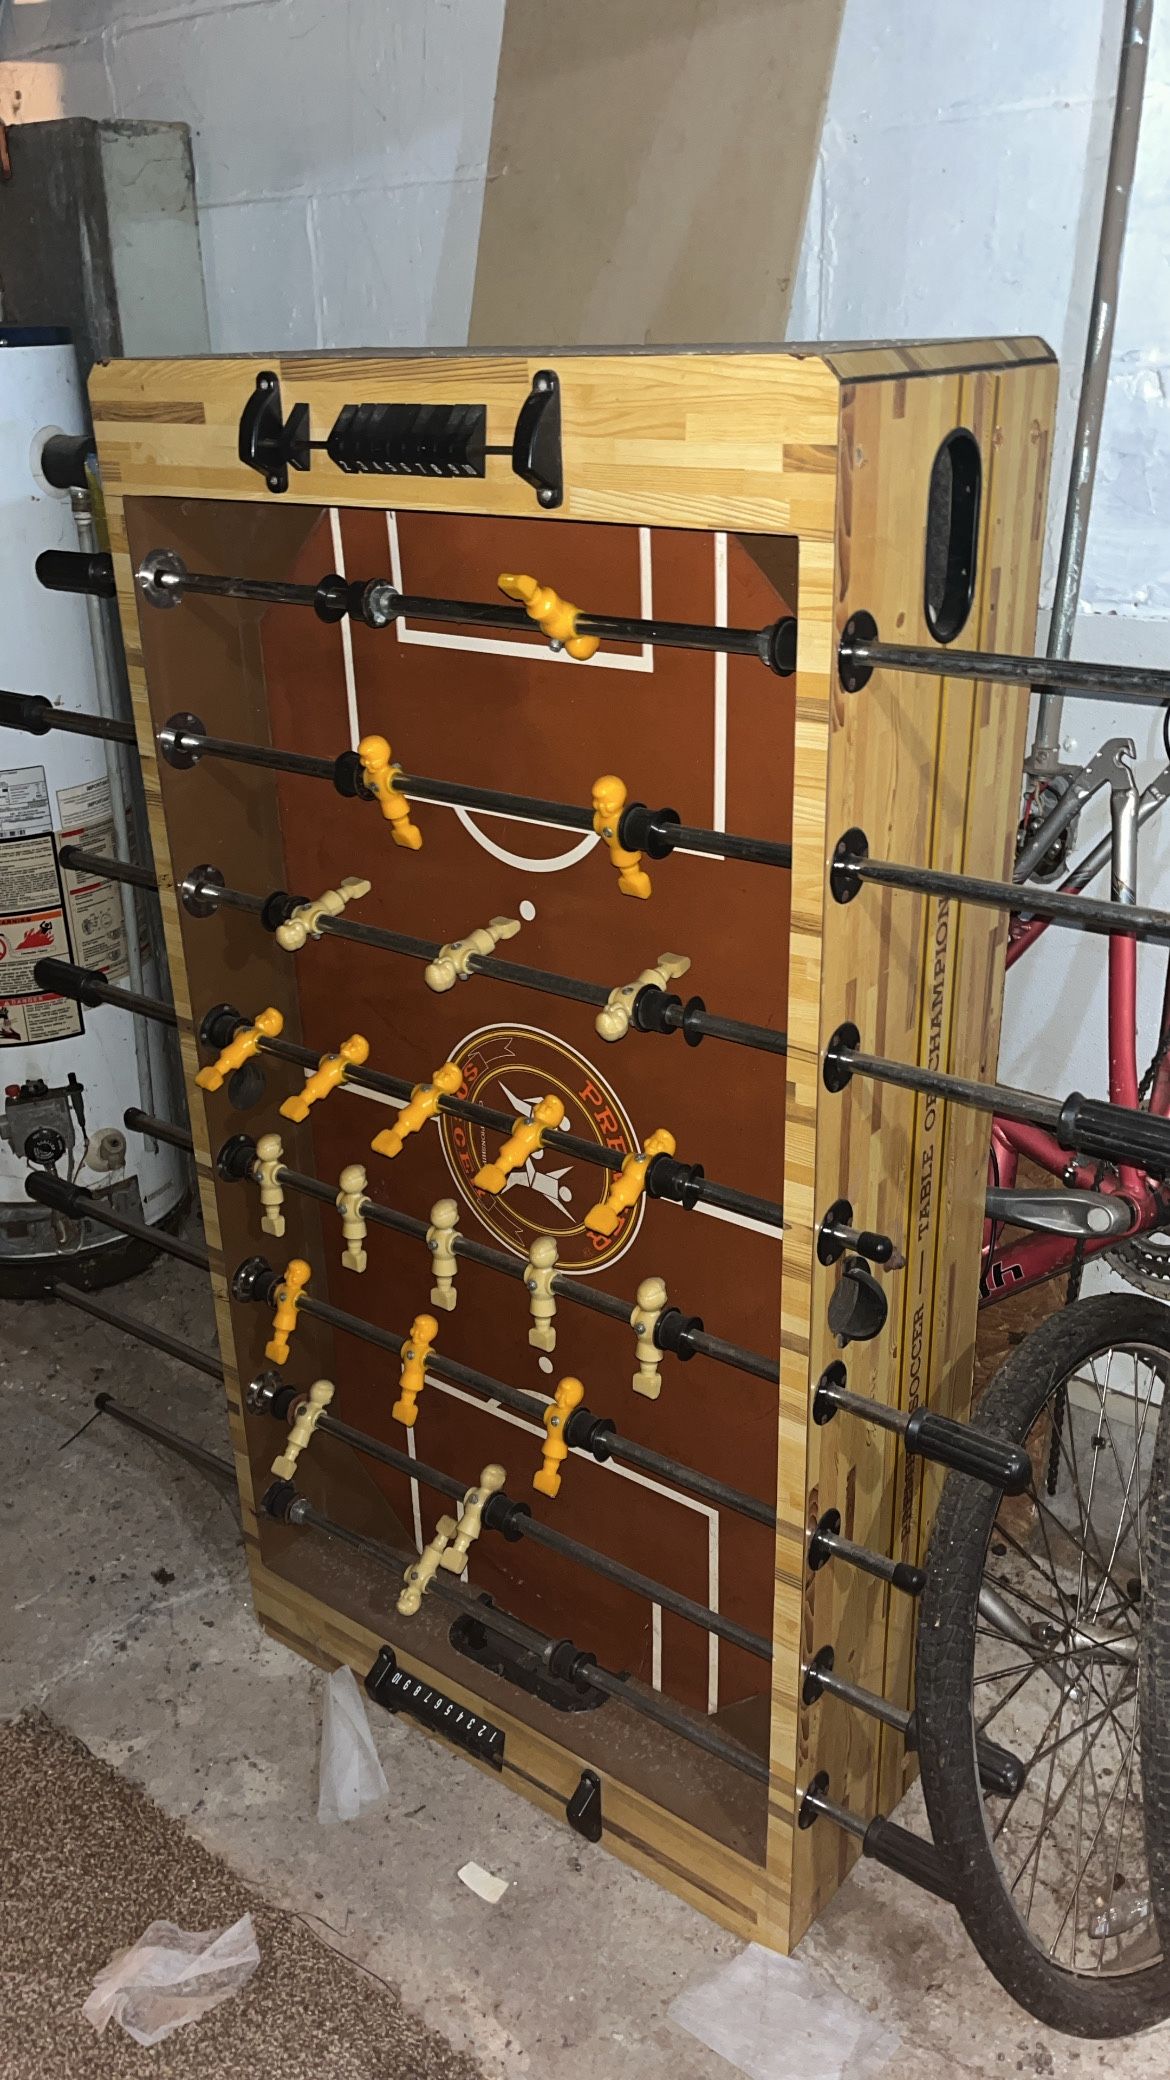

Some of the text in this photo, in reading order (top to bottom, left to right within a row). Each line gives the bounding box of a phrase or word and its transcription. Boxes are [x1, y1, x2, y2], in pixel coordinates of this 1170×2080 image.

[339, 460, 351, 470] 2
[357, 461, 368, 470] 3
[415, 463, 427, 473] 7
[430, 463, 442, 474] 8
[447, 463, 459, 474] 9
[579, 1080, 628, 1250] PRER
[908, 1303, 924, 1414] SOCCER
[918, 1145, 934, 1242] TABLE
[391, 1672, 497, 1742] 1 2 3 4 5 6 7 8 9 10
